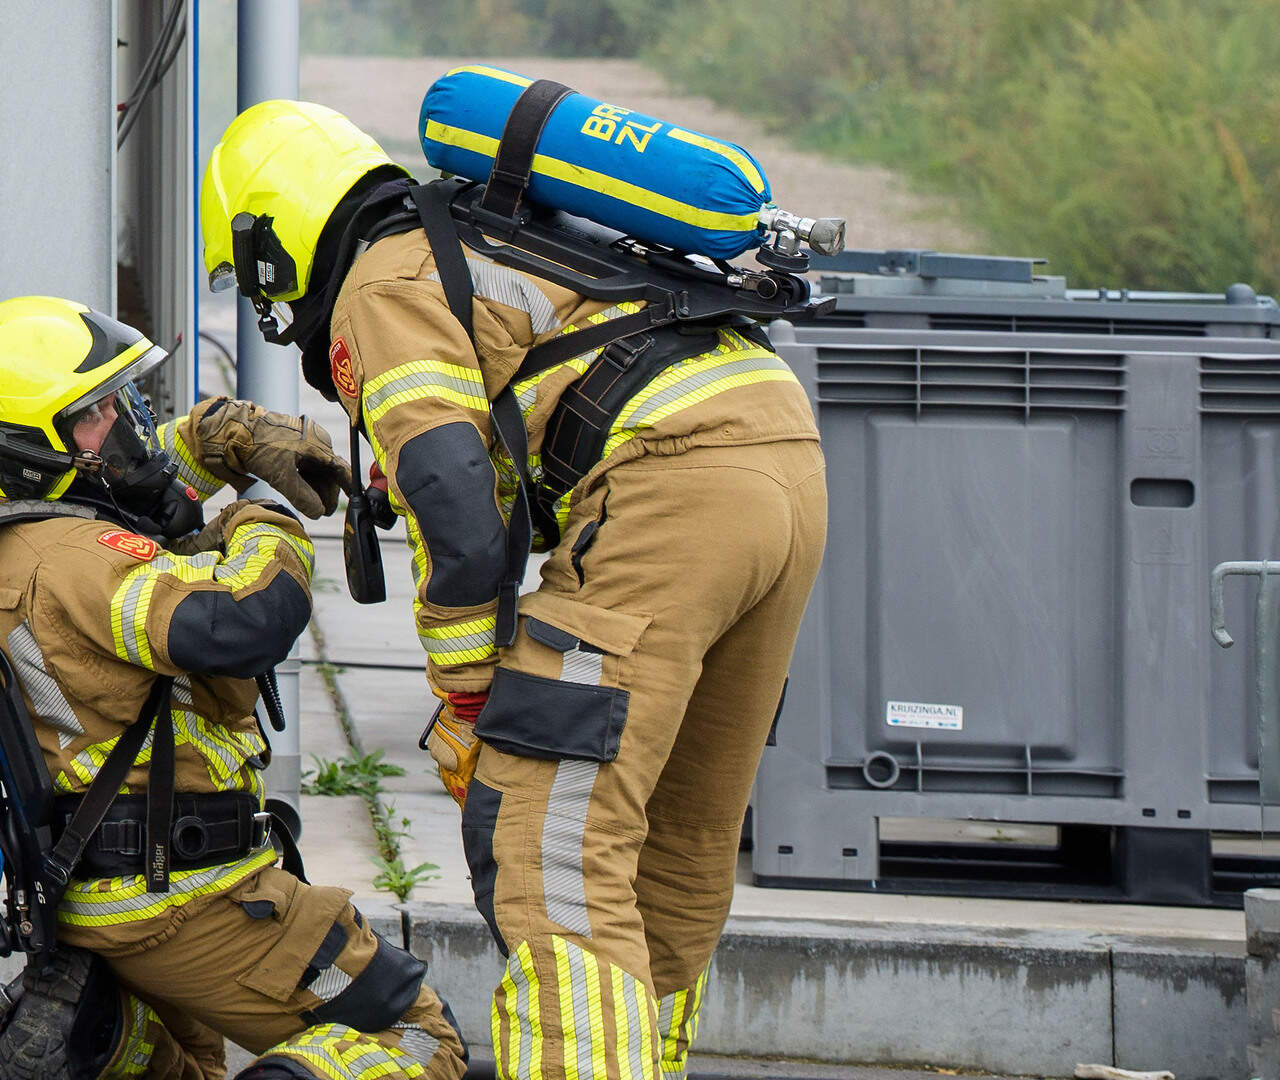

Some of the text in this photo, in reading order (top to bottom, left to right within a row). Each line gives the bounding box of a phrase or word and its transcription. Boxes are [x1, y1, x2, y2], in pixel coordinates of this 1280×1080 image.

[580, 103, 635, 142] BR
[614, 120, 663, 154] ZL
[152, 843, 166, 881] Dräger
